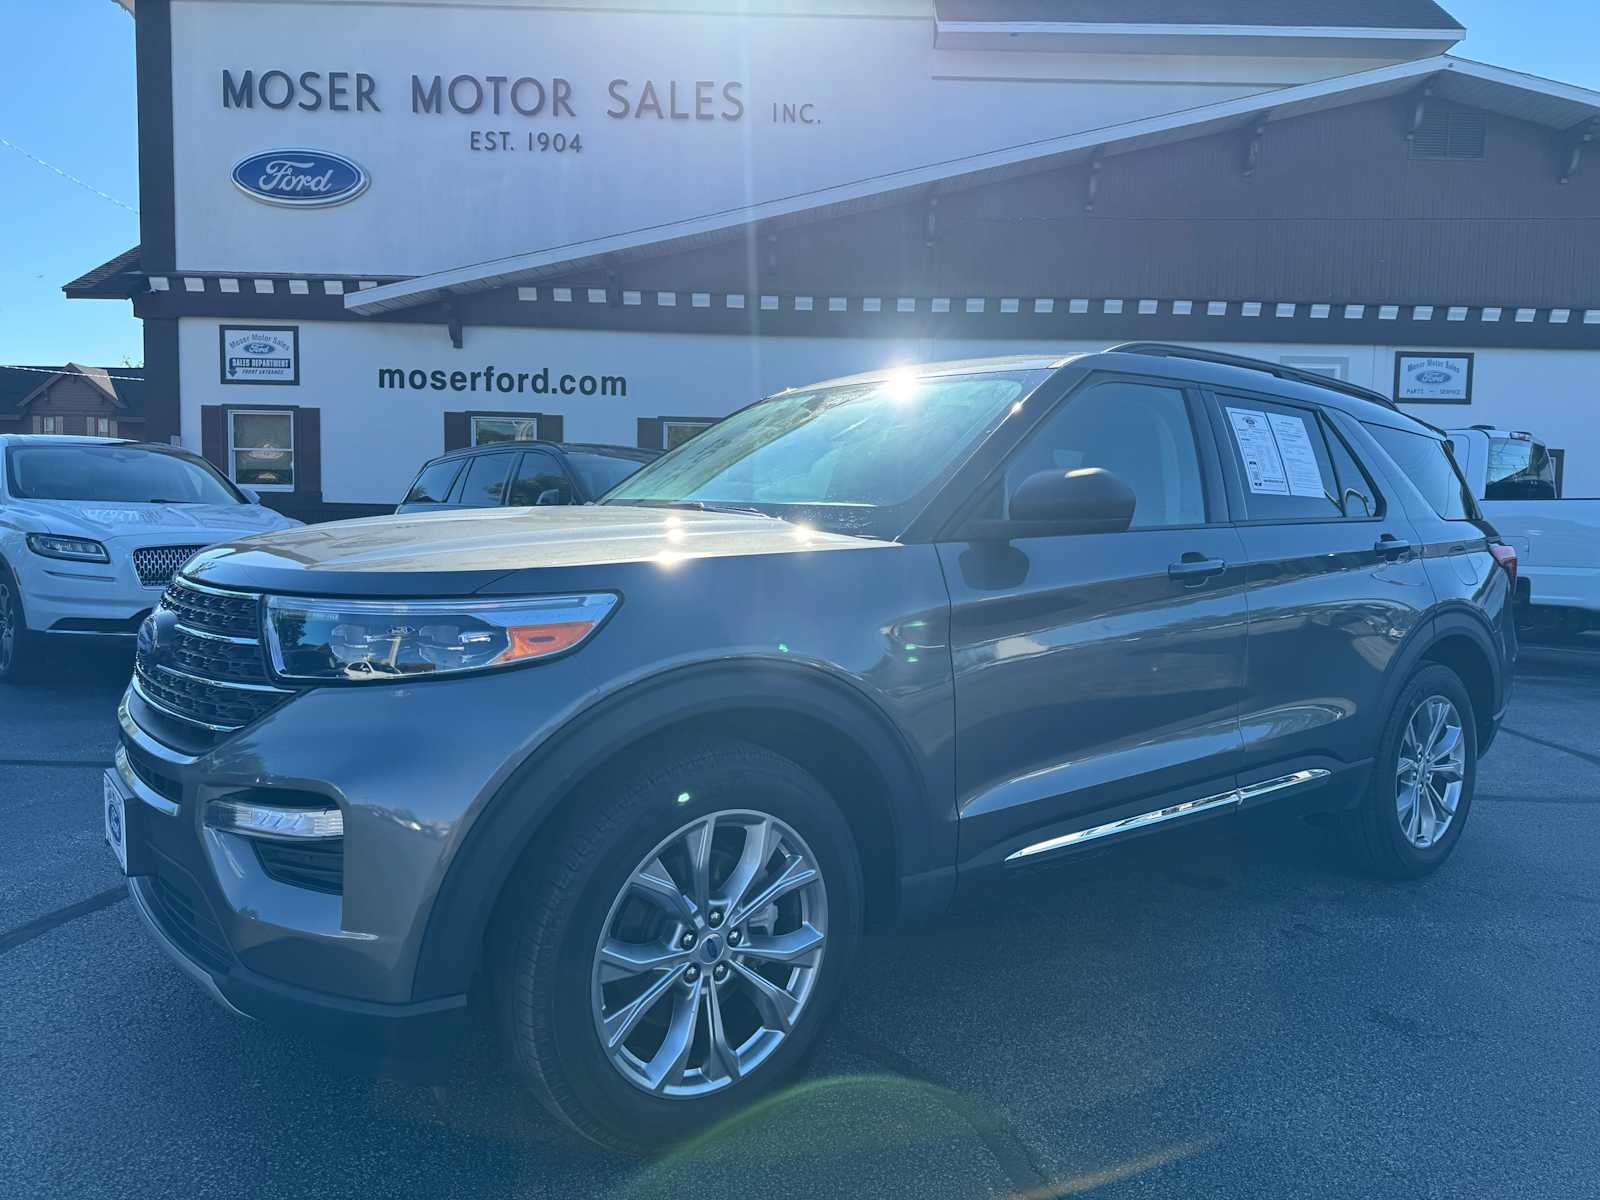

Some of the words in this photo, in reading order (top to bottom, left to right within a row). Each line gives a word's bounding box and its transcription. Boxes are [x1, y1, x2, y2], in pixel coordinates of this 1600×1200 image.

[222, 69, 382, 113] MOSER
[411, 74, 577, 118] MOTOR
[606, 79, 745, 122] SALES
[772, 102, 823, 125] INC.
[470, 131, 515, 151] EST.
[528, 132, 583, 153] 1904
[258, 160, 334, 193] Ford
[229, 336, 250, 349] Moser
[251, 333, 271, 342] Motor
[272, 336, 290, 352] Sales
[248, 343, 271, 354] Ford
[232, 359, 250, 367] SALES
[251, 359, 289, 368] DEPARTMENT
[378, 366, 627, 396] moserford.com
